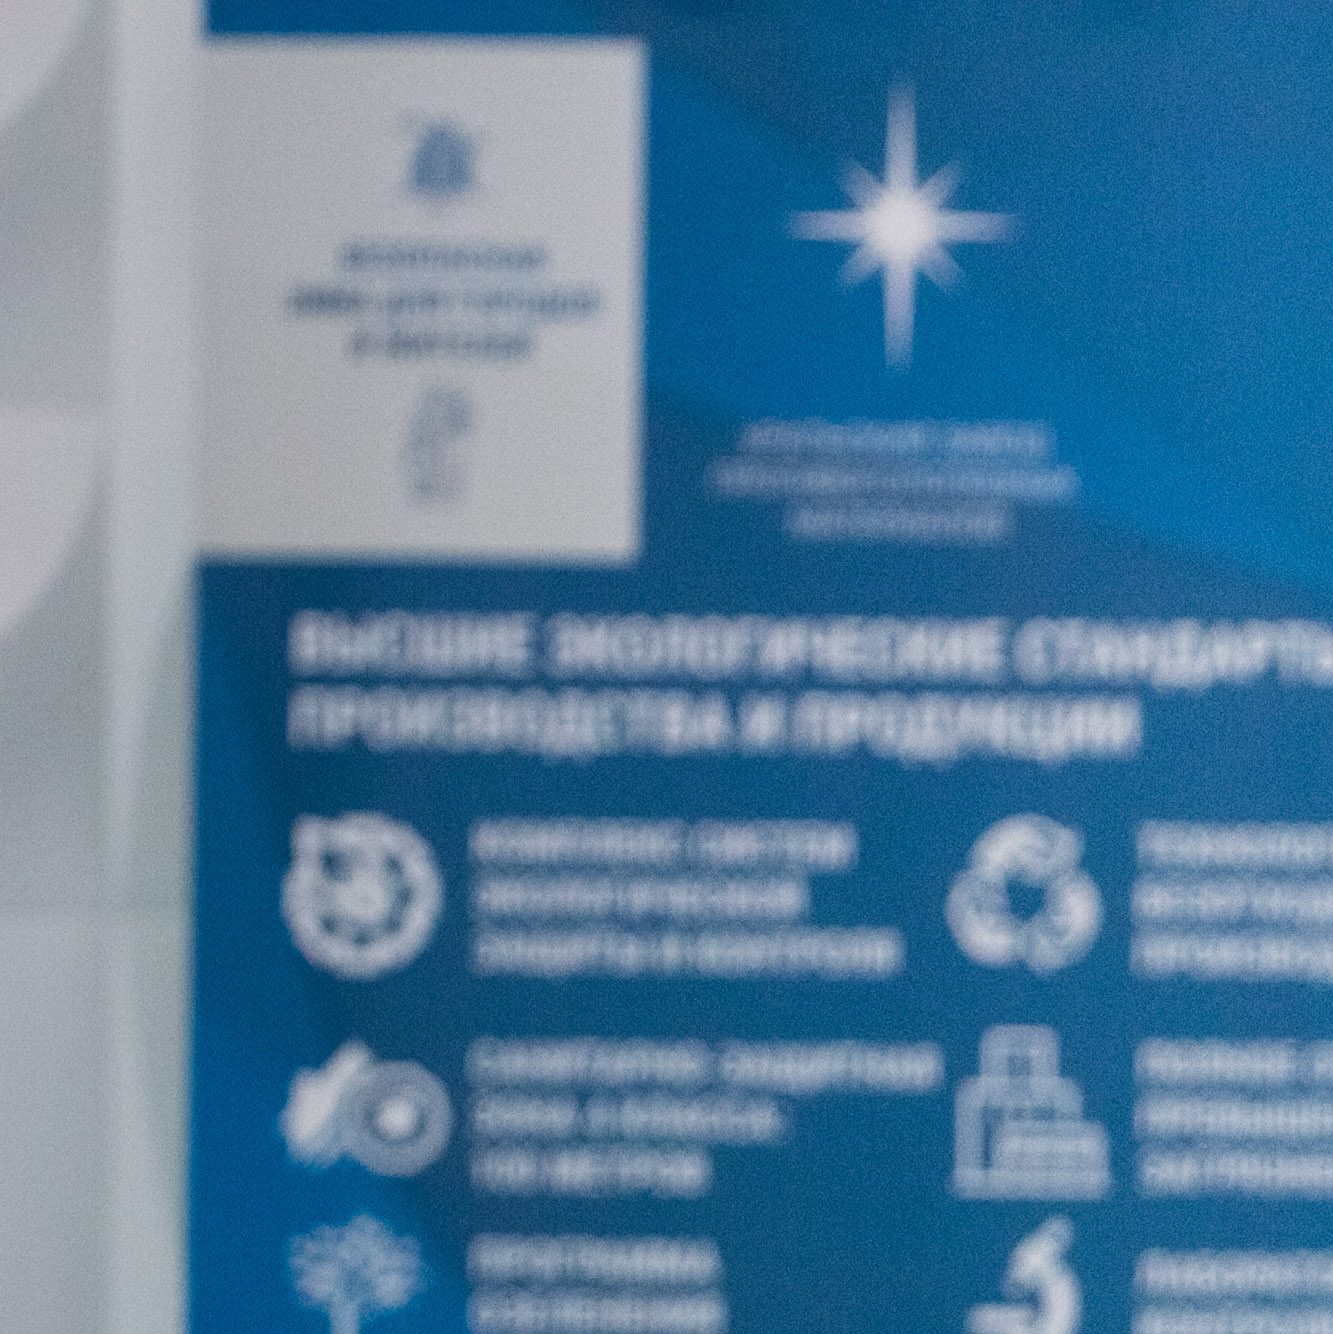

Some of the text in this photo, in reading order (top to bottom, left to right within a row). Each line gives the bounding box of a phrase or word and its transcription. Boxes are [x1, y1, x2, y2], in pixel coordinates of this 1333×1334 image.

[293, 614, 540, 674] ВЫСШИЕ
[546, 616, 1010, 679] ЭКОЛОГИЧЕСКИЕ
[293, 690, 1138, 769] ПРОИЗВОДСТВА И ПРОДУКЦИИ
